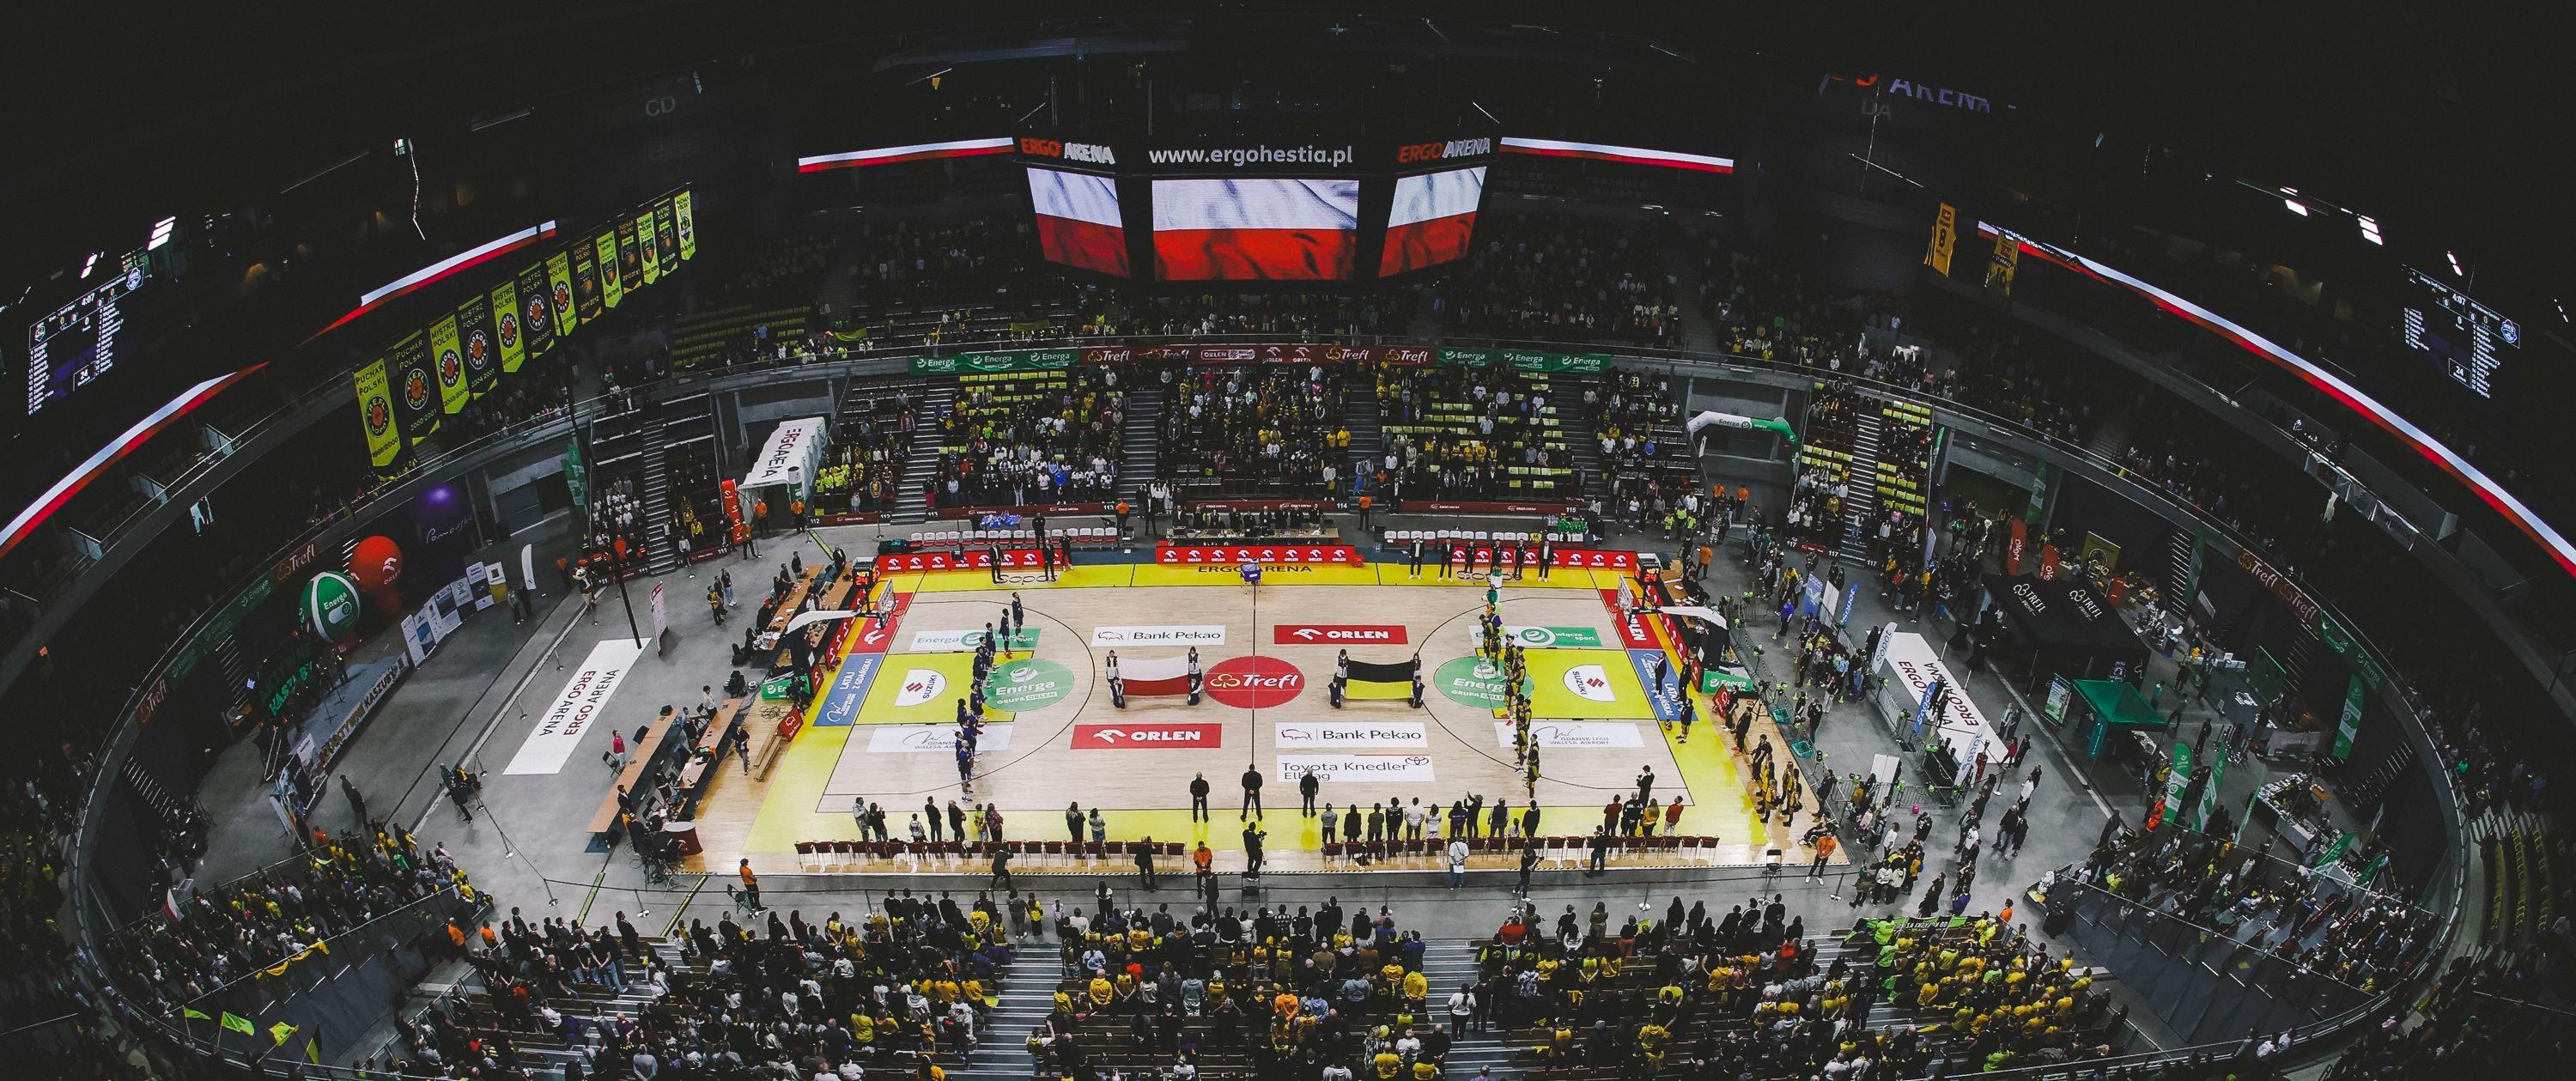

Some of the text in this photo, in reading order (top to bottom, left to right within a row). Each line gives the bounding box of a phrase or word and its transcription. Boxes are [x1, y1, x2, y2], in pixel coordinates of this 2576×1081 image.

[1020, 137, 1115, 164] ERGO ARENA
[1149, 144, 1352, 167] www.ergohestia.pl
[1398, 137, 1491, 163] ERGO ARENA
[521, 270, 541, 286] MISTRZ
[523, 279, 543, 294] POLSKI
[81, 293, 95, 306] 4:07
[494, 287, 513, 301] MISTRZ
[2452, 293, 2466, 306] 4:07
[461, 303, 483, 320] MISTRZ
[495, 297, 515, 312] POLSKI
[463, 313, 485, 328] POLSKI
[501, 315, 516, 334] PROKOM
[431, 321, 455, 338] MISTRZ
[434, 330, 456, 348] POLSKI
[470, 334, 487, 354] PROKOM
[396, 339, 424, 361] PUCHAR
[1103, 349, 1130, 362] Trefl
[1341, 349, 1370, 361] Trefl
[1400, 349, 1428, 363] Trefl
[1457, 351, 1485, 360] Energa
[1516, 354, 1543, 363] Energa
[399, 351, 424, 371] POLSKI
[441, 352, 458, 373] PROKOM
[1573, 357, 1601, 366] Energa
[80, 369, 88, 380] 24
[355, 365, 384, 385] PUCHAR
[2456, 366, 2464, 376] 24
[359, 376, 386, 396] POLSKI
[407, 373, 424, 391] TREFL
[368, 398, 386, 416] TREFL
[1719, 418, 1740, 427] Energa
[289, 544, 315, 571] Trefl
[856, 577, 868, 586] 24
[1643, 574, 1657, 583] 24
[2251, 560, 2278, 588] Trefl
[323, 592, 348, 610] Energa
[2026, 591, 2047, 613] TREFL
[2082, 597, 2103, 618] TREFL
[2292, 592, 2317, 619] Trefl
[1133, 631, 1220, 640] Bank Pekao
[1327, 630, 1388, 639] ORLEN
[1877, 629, 1891, 665] Sopot
[840, 671, 855, 690] LATAJ
[1243, 674, 1298, 689] Trefl
[1572, 671, 1589, 695] SUZUKI
[1720, 679, 1747, 688] Energa
[1899, 661, 1928, 689] ERGO
[922, 674, 938, 699] SUZUKI
[995, 680, 1055, 696] Energa
[1451, 689, 1480, 698] GRUPA
[147, 679, 167, 712] Trefl
[539, 670, 597, 737] ERGO ARENA
[563, 669, 620, 736] ERGO ARENA
[996, 692, 1056, 705] GRUPA ORLEN
[1949, 695, 1979, 726] ERGO
[1131, 731, 1201, 741] ORLEN
[1323, 730, 1422, 739] Bank Pekao
[1282, 762, 1406, 773] Toyota Knedler
